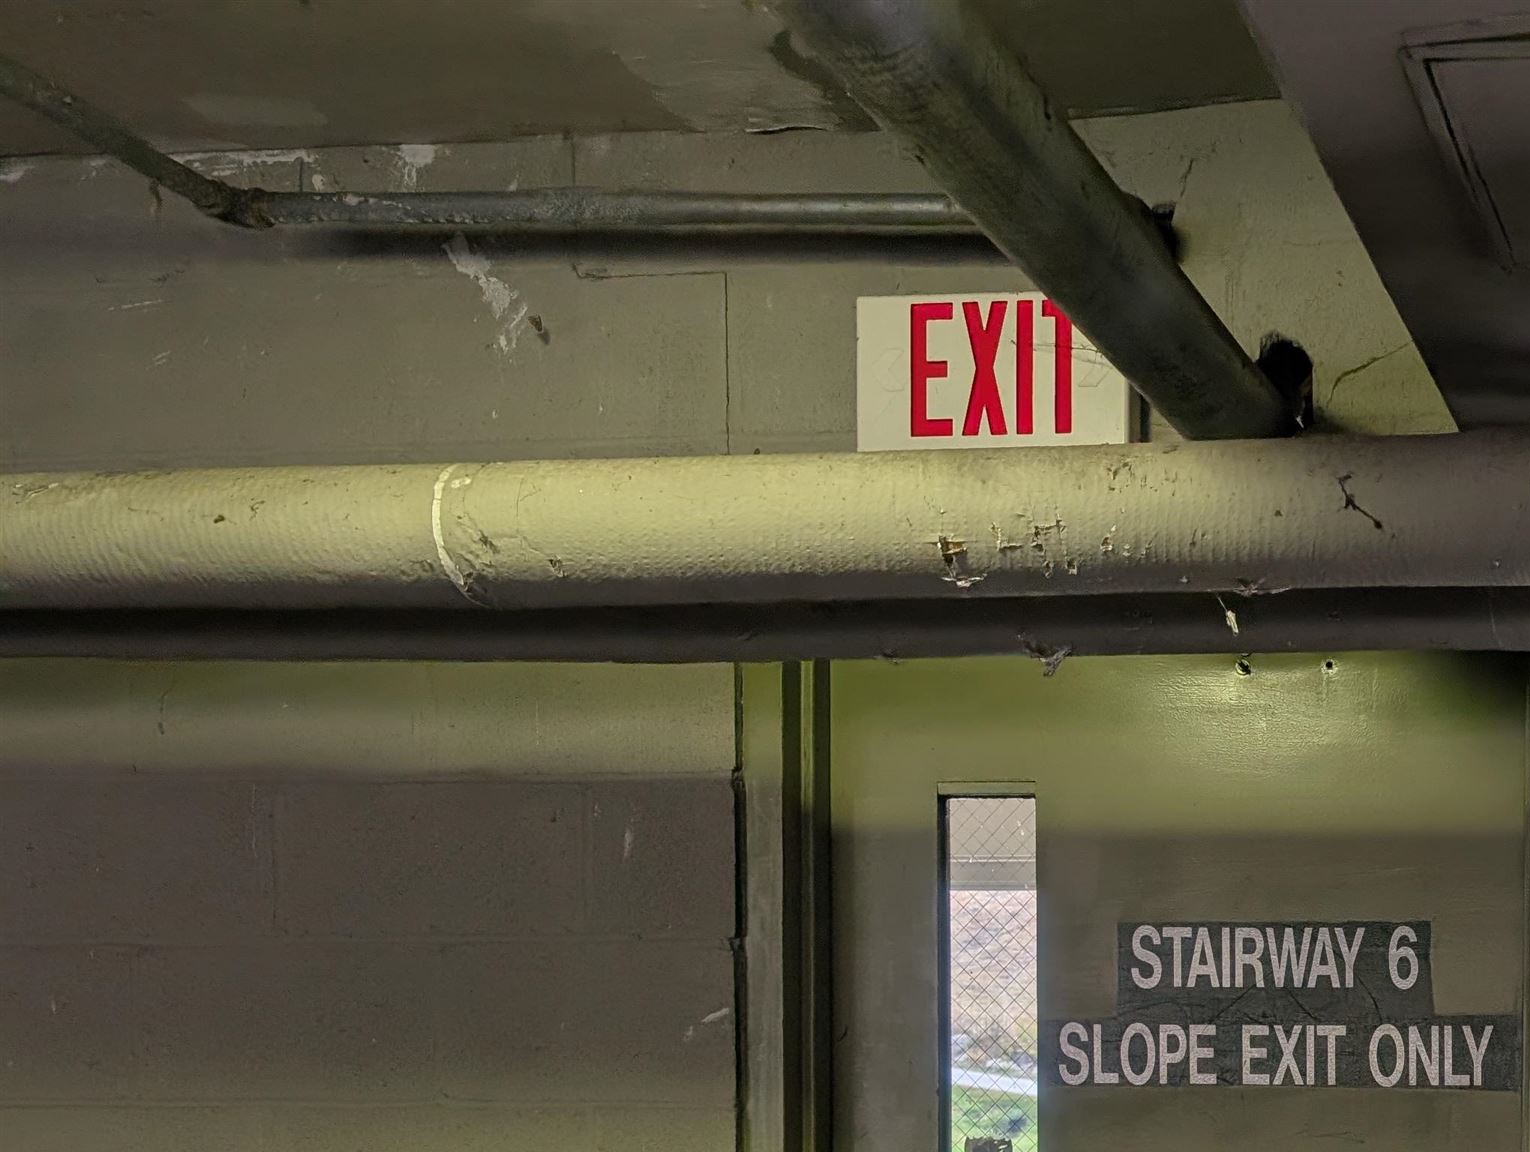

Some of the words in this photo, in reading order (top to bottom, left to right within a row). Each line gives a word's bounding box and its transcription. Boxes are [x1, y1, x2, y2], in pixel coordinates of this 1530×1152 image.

[910, 299, 1072, 437] EXIT
[1130, 924, 1365, 990] STAIRWAY
[1387, 925, 1420, 990] 6
[1057, 1021, 1218, 1087] SLOPE
[1241, 1023, 1347, 1087] EXIT
[1367, 1023, 1495, 1089] ONLY
